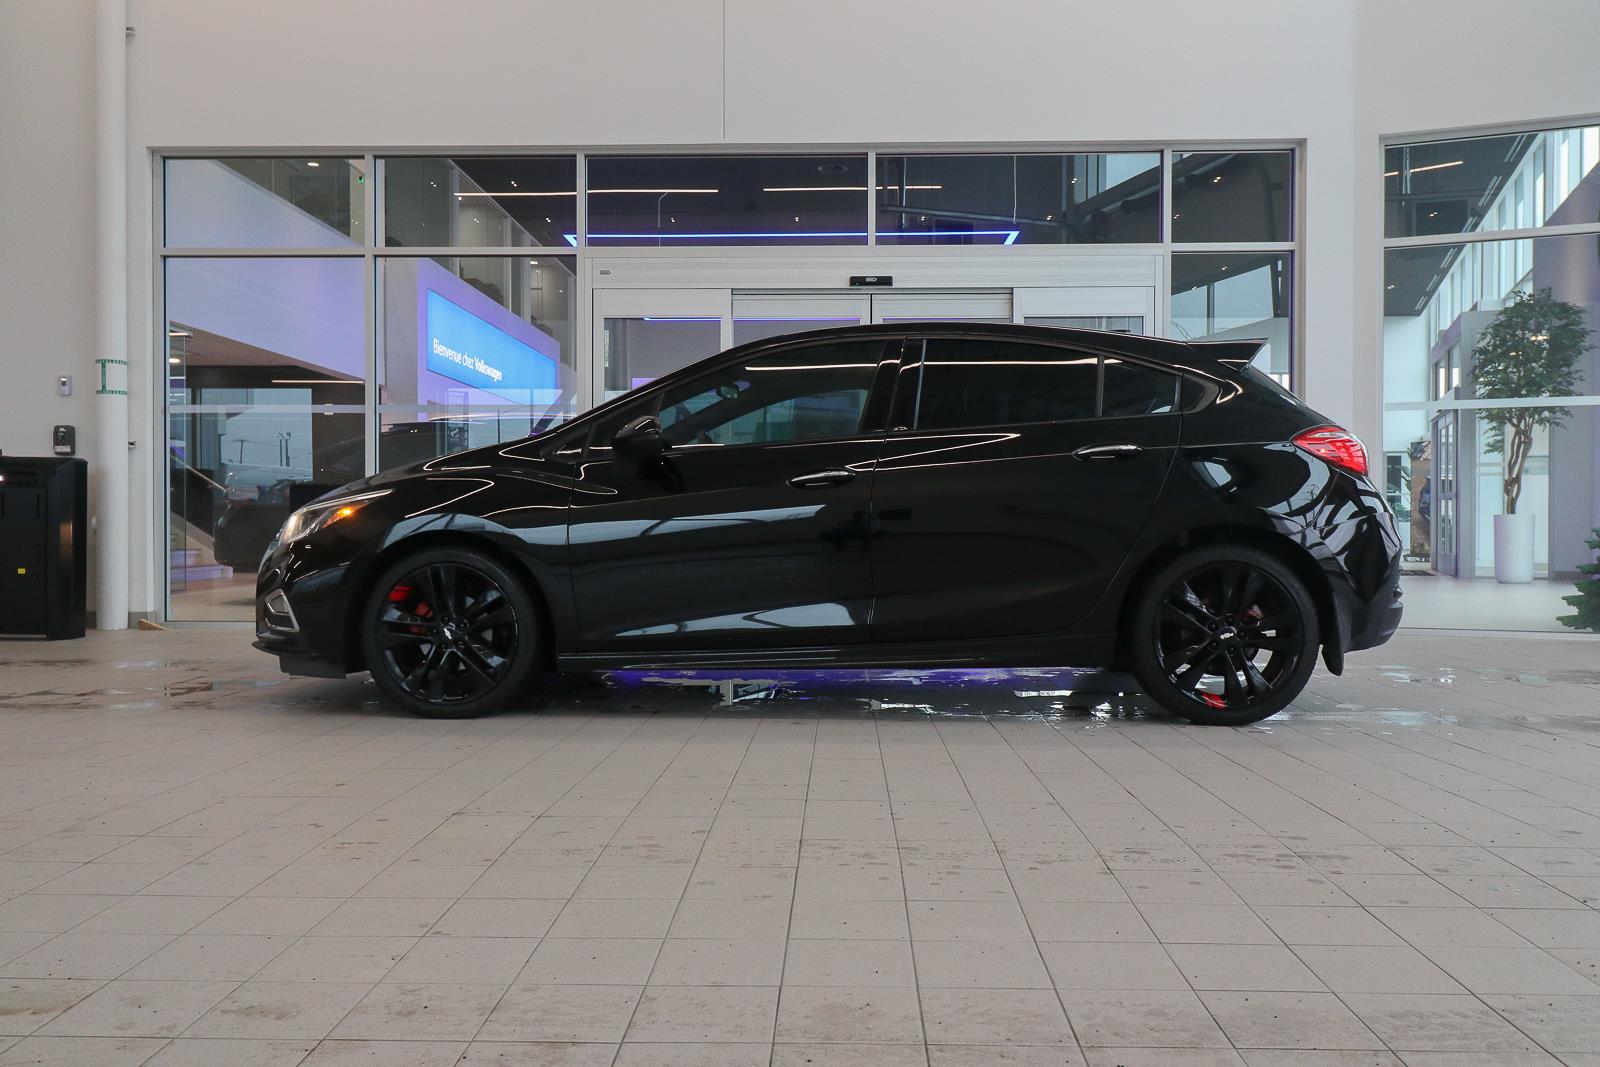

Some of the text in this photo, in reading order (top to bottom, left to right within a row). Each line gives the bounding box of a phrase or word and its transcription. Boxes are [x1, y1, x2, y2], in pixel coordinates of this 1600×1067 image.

[433, 338, 503, 382] Bienvenue chez Volkswagen
